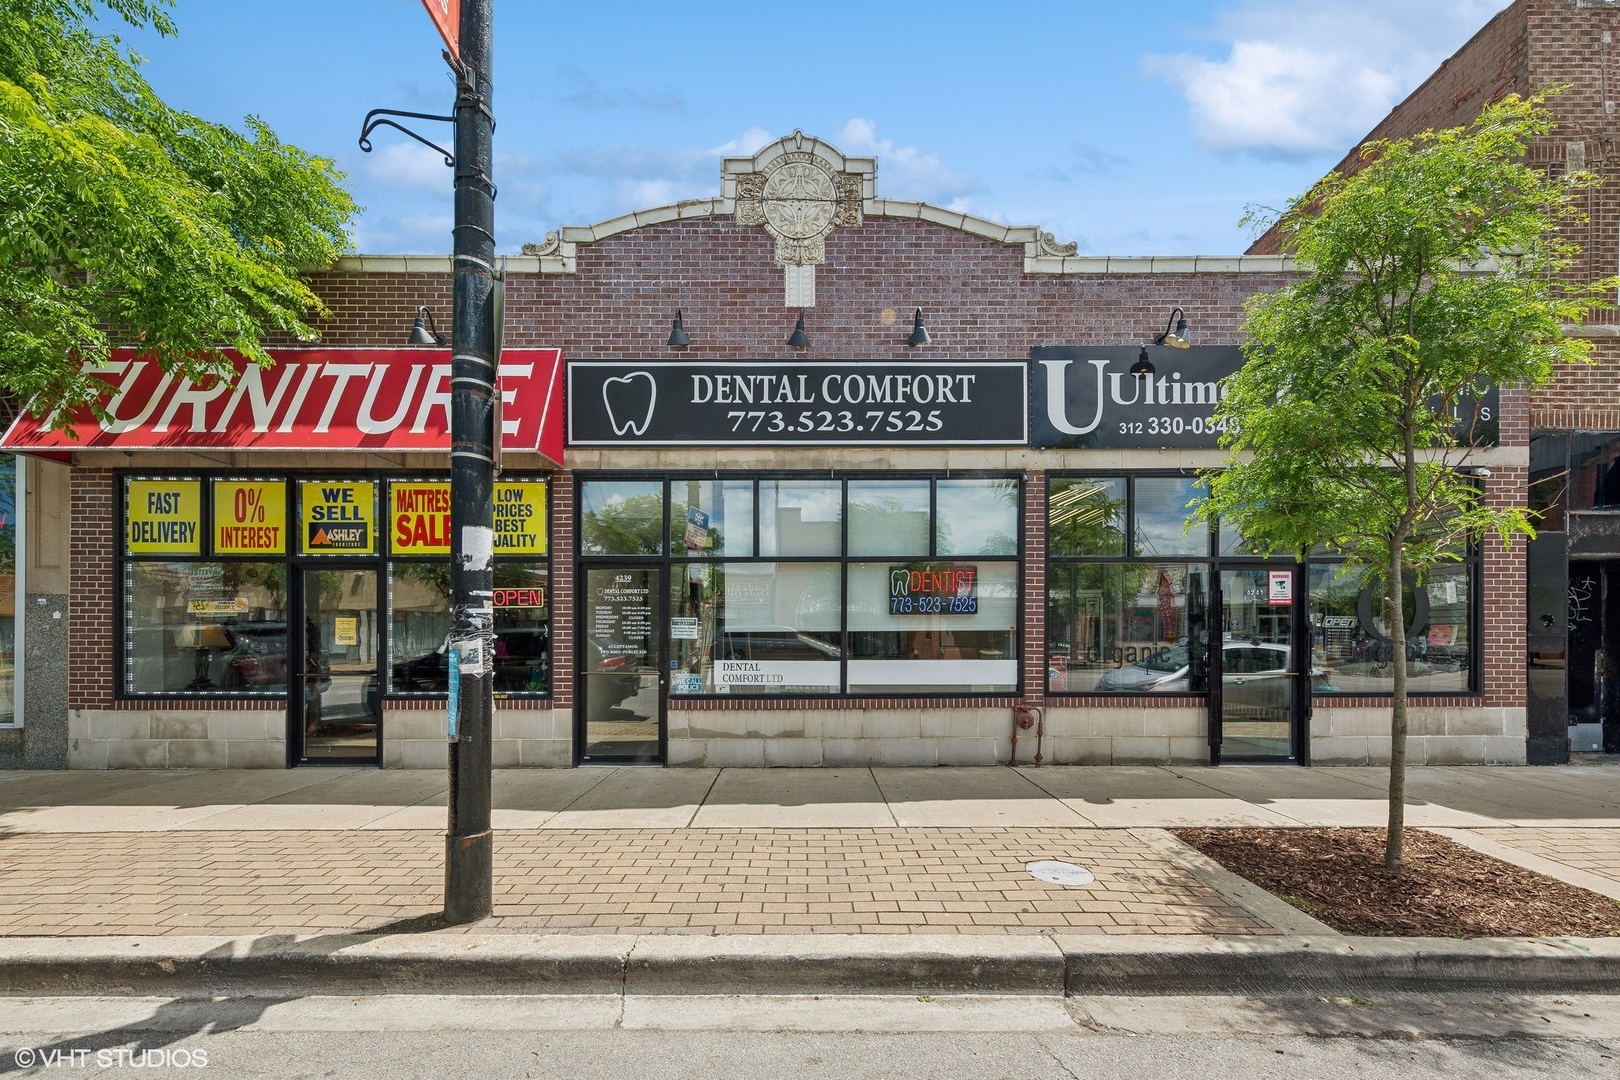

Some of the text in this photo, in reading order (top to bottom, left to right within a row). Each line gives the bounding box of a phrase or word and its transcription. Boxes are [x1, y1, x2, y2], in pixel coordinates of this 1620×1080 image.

[691, 374, 976, 404] DENTAL COMFORT
[1038, 359, 1111, 435] U
[726, 410, 944, 432] 773.523.7525
[1119, 422, 1143, 434] 312
[148, 492, 181, 514] FAST
[321, 487, 354, 503] WE
[396, 489, 451, 513] MATTRES
[497, 488, 524, 502] LOW
[234, 487, 266, 523] 0%
[311, 505, 364, 521] SELL
[493, 503, 533, 518] RICES
[131, 520, 197, 543] DELIVERY
[395, 513, 451, 548] SALE
[495, 518, 526, 532] BEST
[220, 526, 280, 548] INTEREST
[326, 528, 363, 541] ASHLEY
[493, 533, 537, 548] UALITY
[910, 571, 976, 592] DENTIST
[493, 589, 541, 606] OPEN
[890, 596, 976, 614] 773-523-7525
[1325, 618, 1356, 626] OPEN
[722, 662, 761, 672] DENTAL
[722, 673, 784, 683] COMFORT LTD
